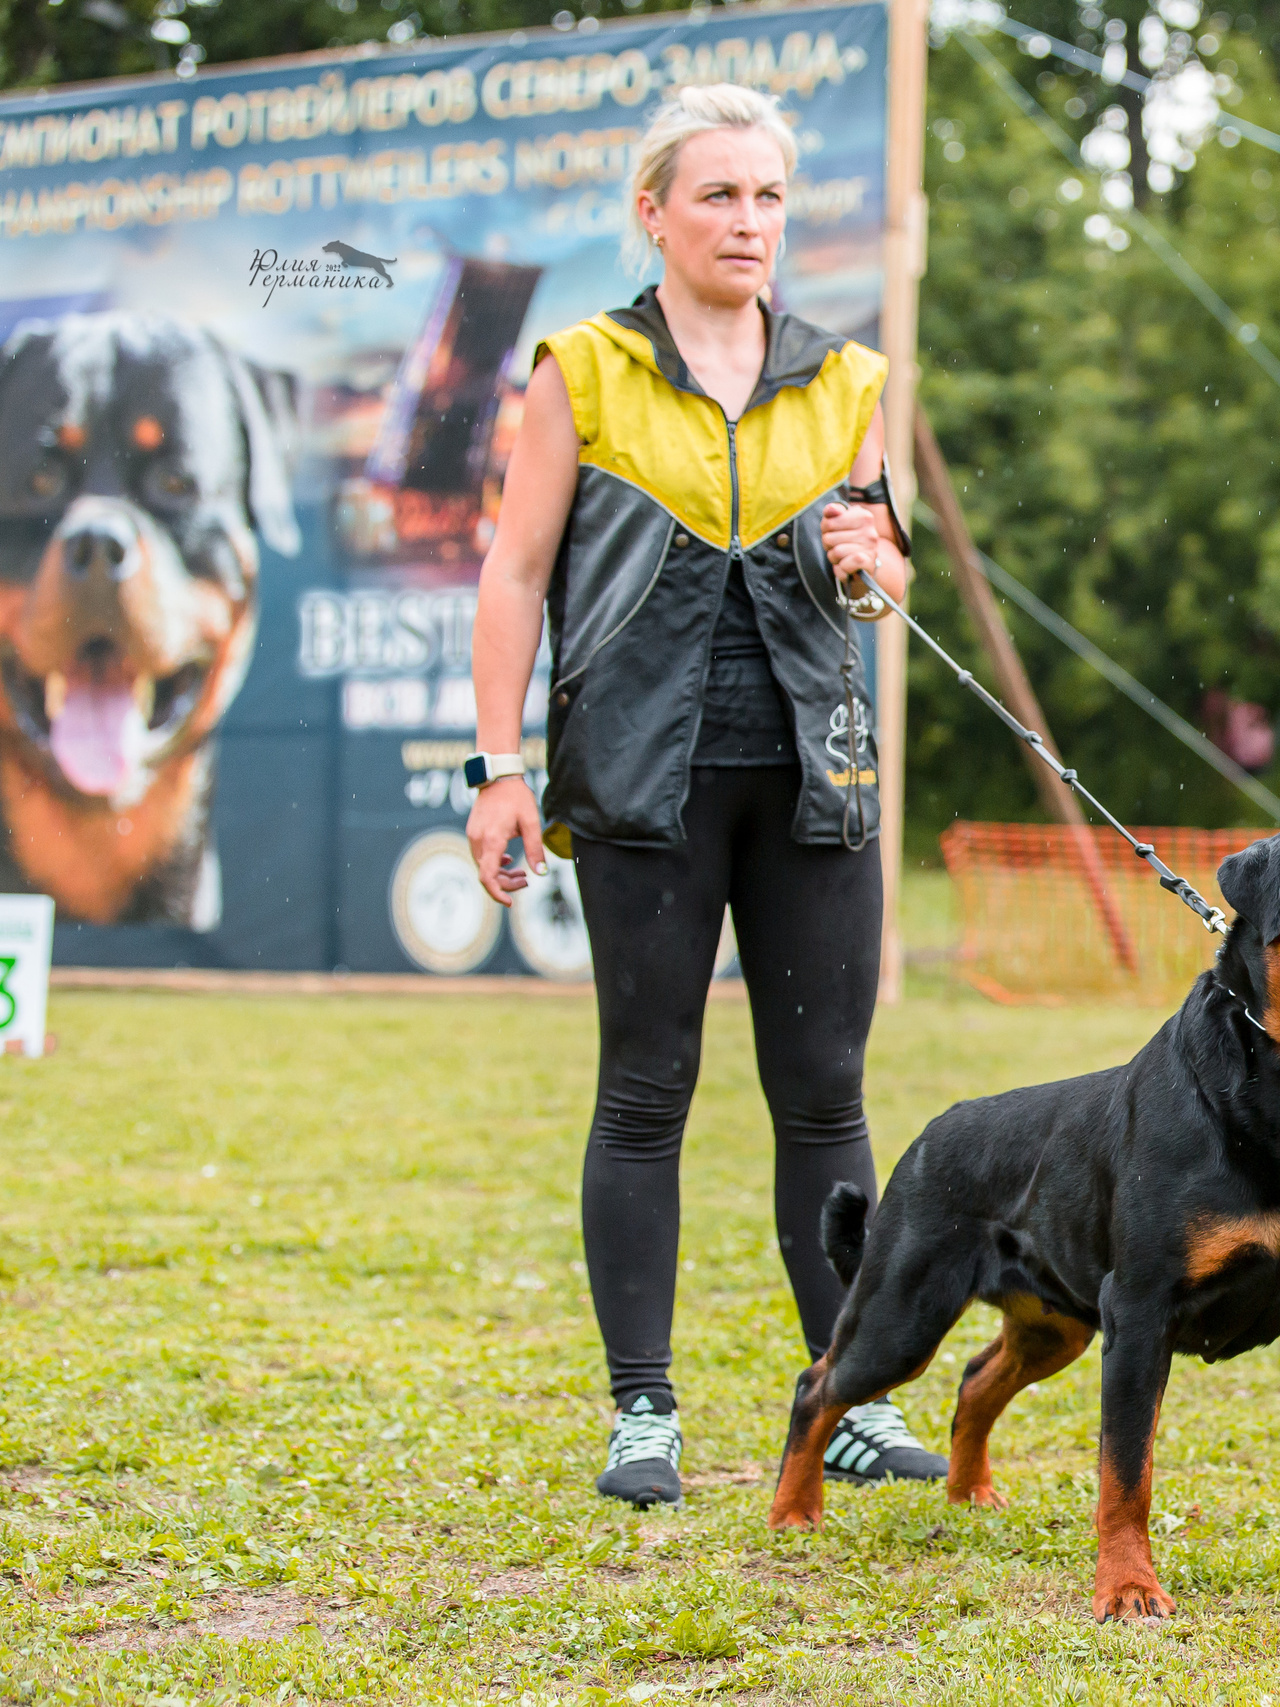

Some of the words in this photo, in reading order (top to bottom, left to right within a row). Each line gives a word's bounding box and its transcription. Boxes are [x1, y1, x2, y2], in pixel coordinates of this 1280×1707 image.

[0, 101, 187, 170] МПИОНАТ
[190, 67, 477, 150] РОТВЕЙЛЕРОВ
[238, 139, 509, 215] ROTTWEILERS
